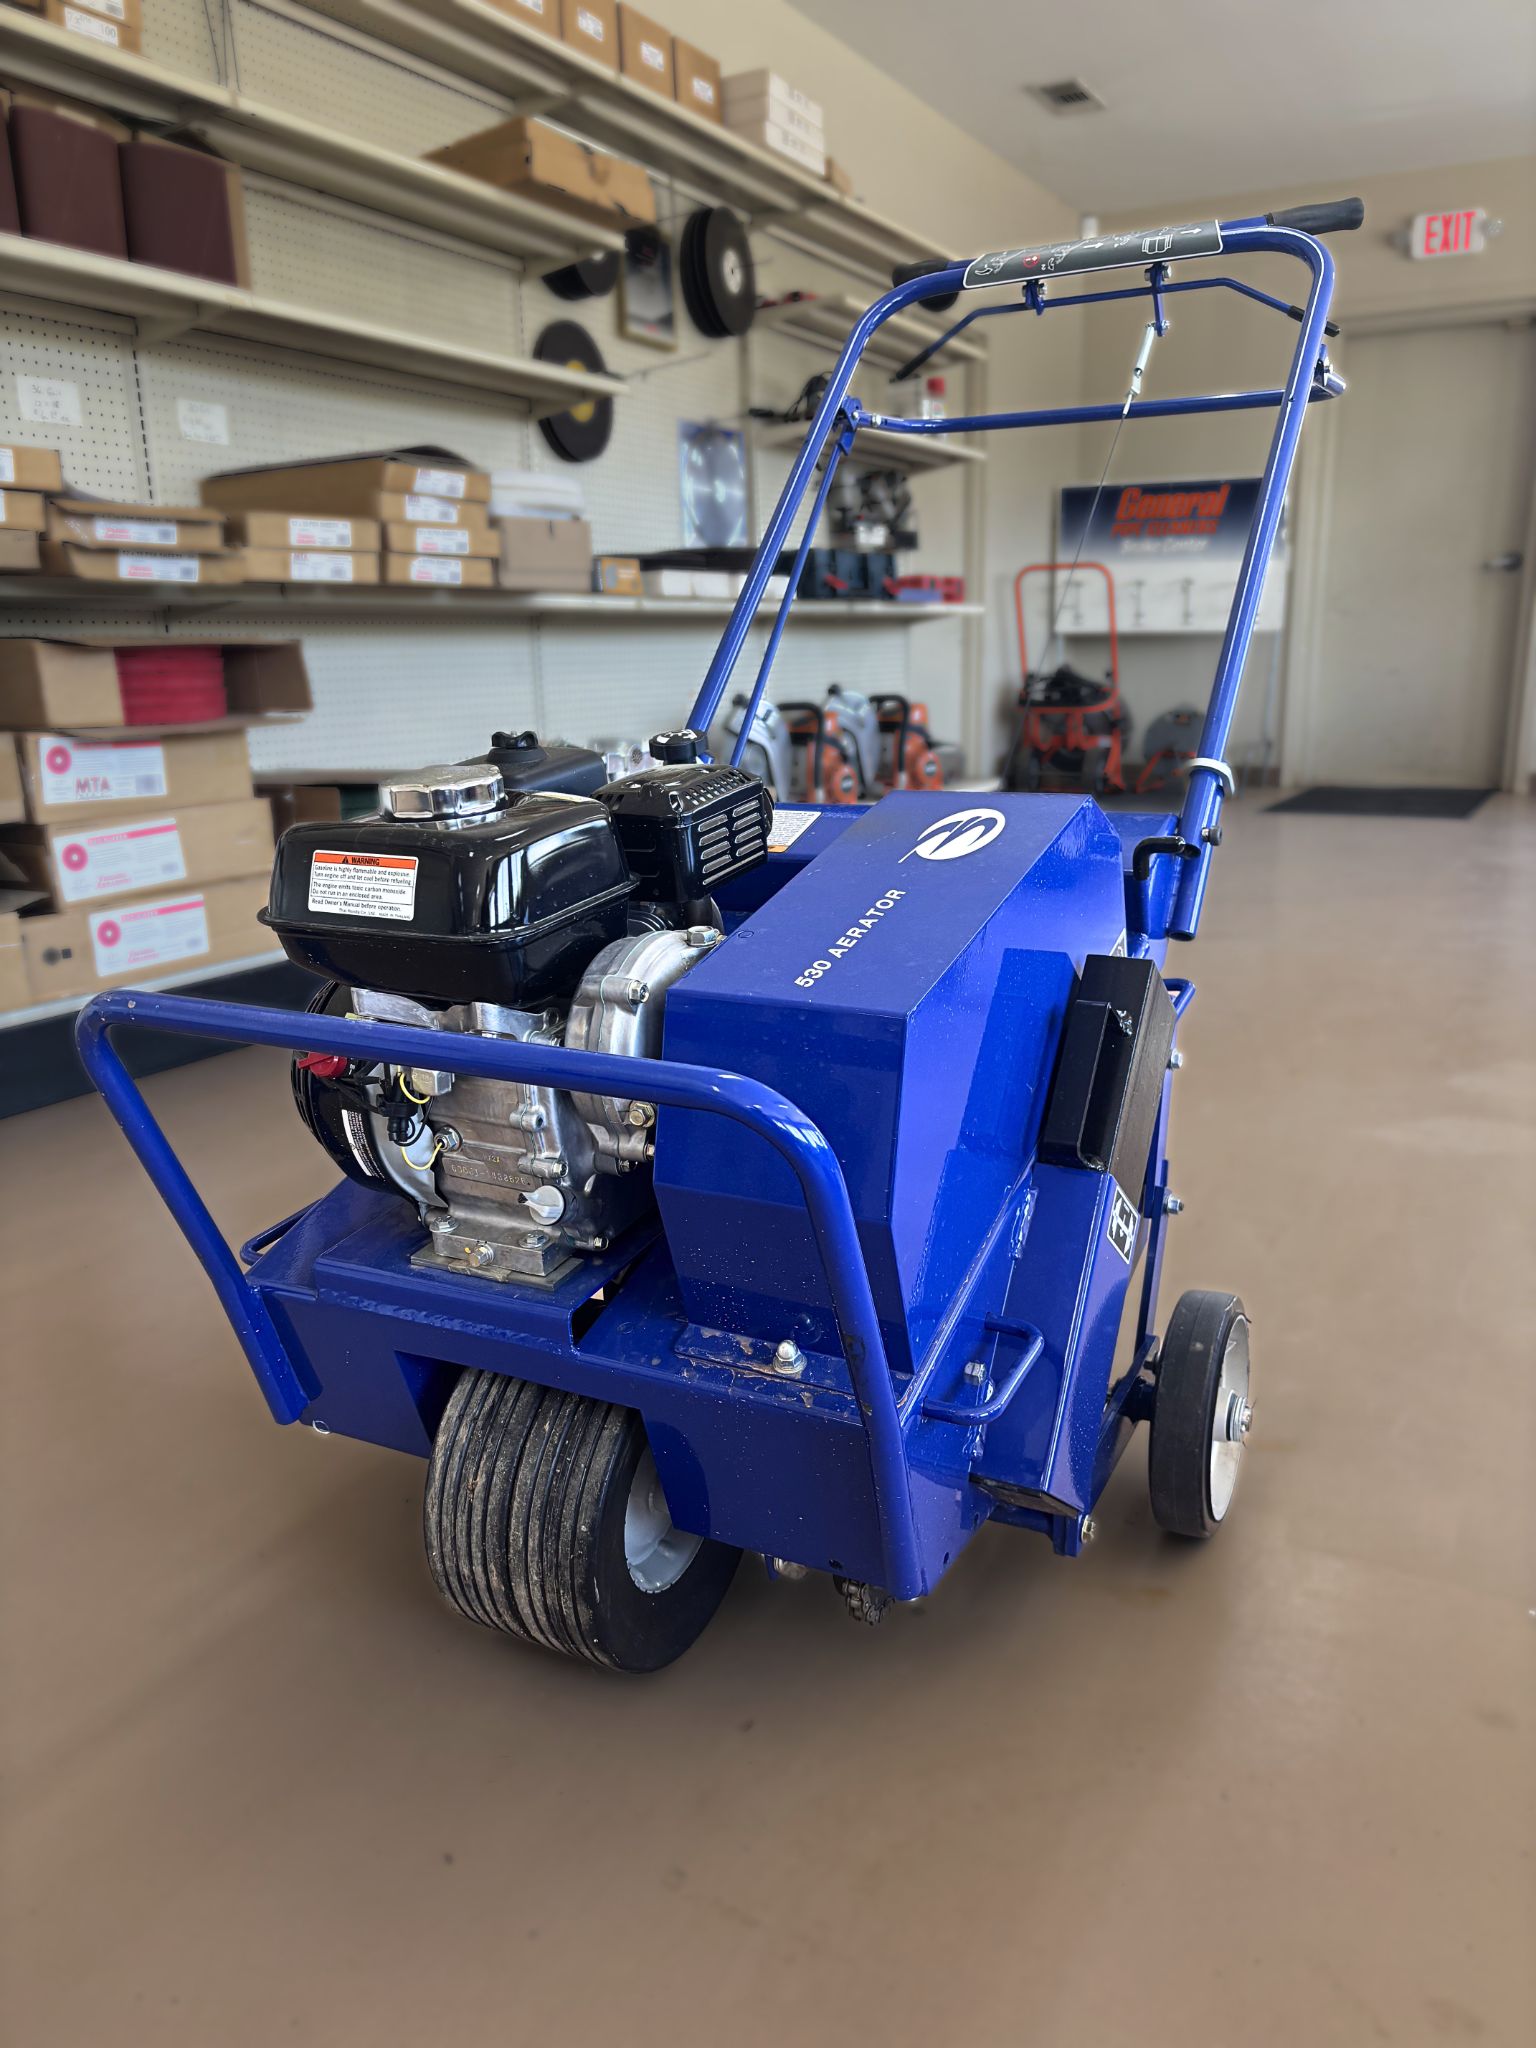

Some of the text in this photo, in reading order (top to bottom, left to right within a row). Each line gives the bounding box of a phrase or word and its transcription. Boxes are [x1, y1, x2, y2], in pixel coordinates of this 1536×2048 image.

[1425, 211, 1476, 255] EXIT
[1115, 482, 1231, 521] General
[76, 776, 111, 794] MTA
[352, 857, 380, 866] WARNING
[795, 889, 906, 988] 530 AERATOR
